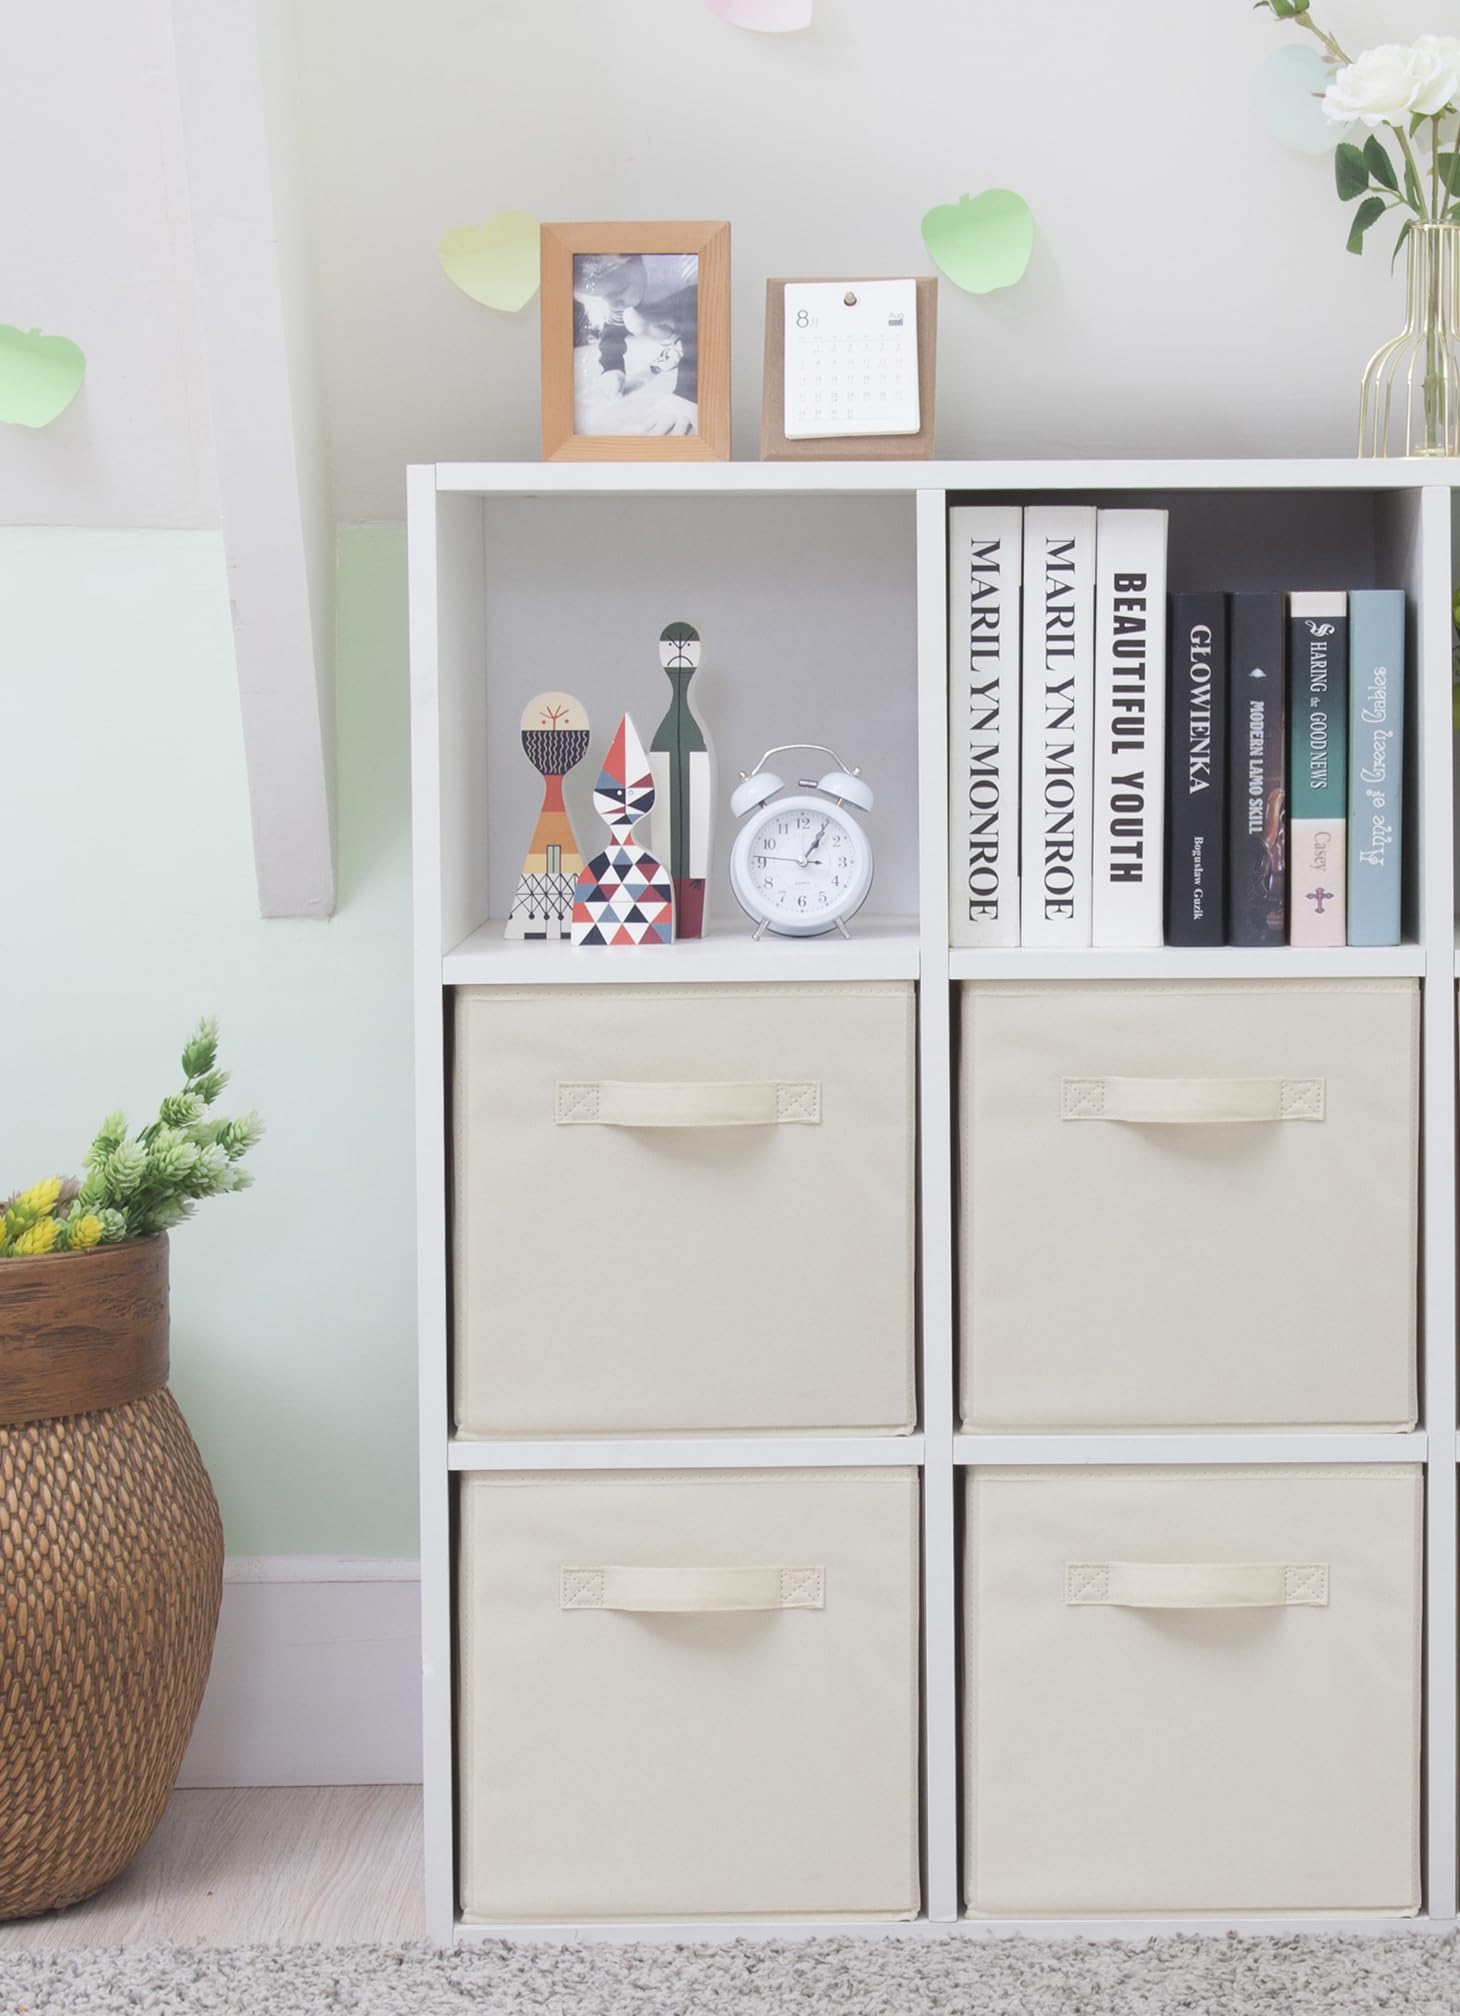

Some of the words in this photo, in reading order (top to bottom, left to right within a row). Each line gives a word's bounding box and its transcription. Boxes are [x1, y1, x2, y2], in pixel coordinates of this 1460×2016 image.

[969, 537, 1001, 732] MARILYN
[1045, 536, 1076, 732] MARILYN
[1111, 572, 1148, 755] BEAUTIFUL
[1310, 696, 1321, 708] the
[1360, 666, 1388, 724] Gables
[1249, 700, 1265, 757] MODERN
[1309, 712, 1328, 750] GOOD
[1309, 751, 1328, 789] NEWS
[1360, 729, 1394, 783] Green
[1249, 759, 1264, 795] LAMO
[1248, 797, 1264, 835] SKILL
[1365, 788, 1386, 809] of
[778, 823, 789, 835] 11
[797, 818, 811, 830] 12
[832, 836, 841, 848] 2
[968, 742, 1000, 922] MONROE
[1043, 741, 1075, 921] MONROE
[1110, 770, 1145, 883] YOUTH
[1359, 815, 1393, 867] Anne
[763, 838, 777, 850] 10
[838, 856, 848, 868] 3
[1308, 831, 1332, 873] Casey
[757, 857, 767, 869] 9
[831, 875, 839, 887] 4
[763, 877, 774, 889] 8
[797, 895, 807, 907] 6
[818, 892, 828, 904] 5
[1192, 887, 1204, 921] Guzik
